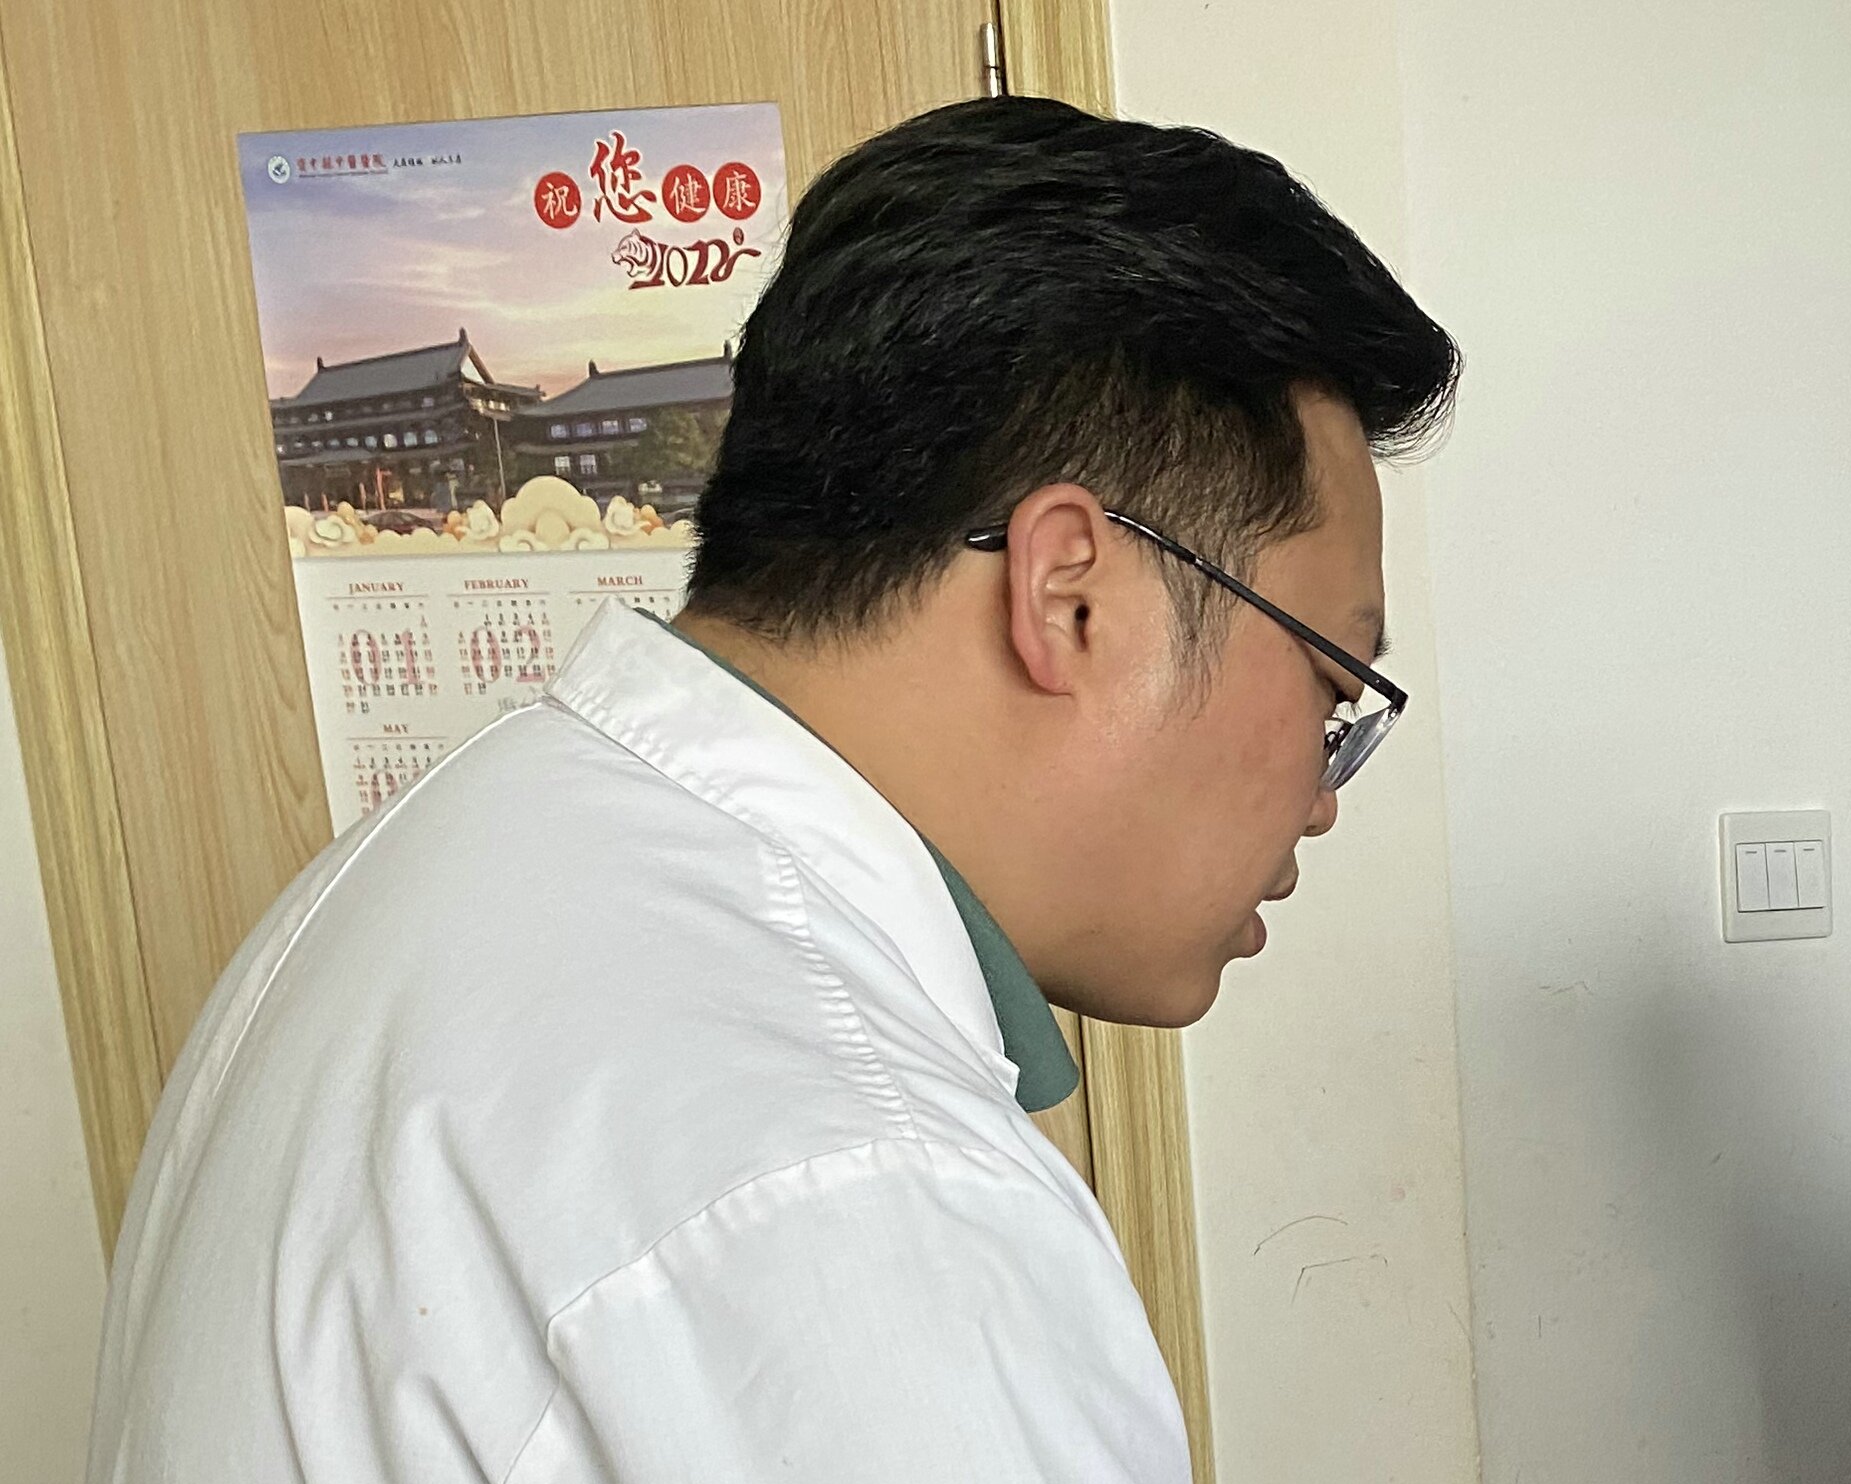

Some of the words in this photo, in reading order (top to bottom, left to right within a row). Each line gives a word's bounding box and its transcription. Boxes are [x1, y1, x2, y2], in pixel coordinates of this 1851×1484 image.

[538, 131, 759, 224] 祝您健康
[620, 233, 762, 290] 2022
[464, 579, 529, 591] FEBRUARY
[597, 576, 643, 587] MARCH
[349, 582, 405, 595] JANUARY
[383, 724, 409, 734] MAY
